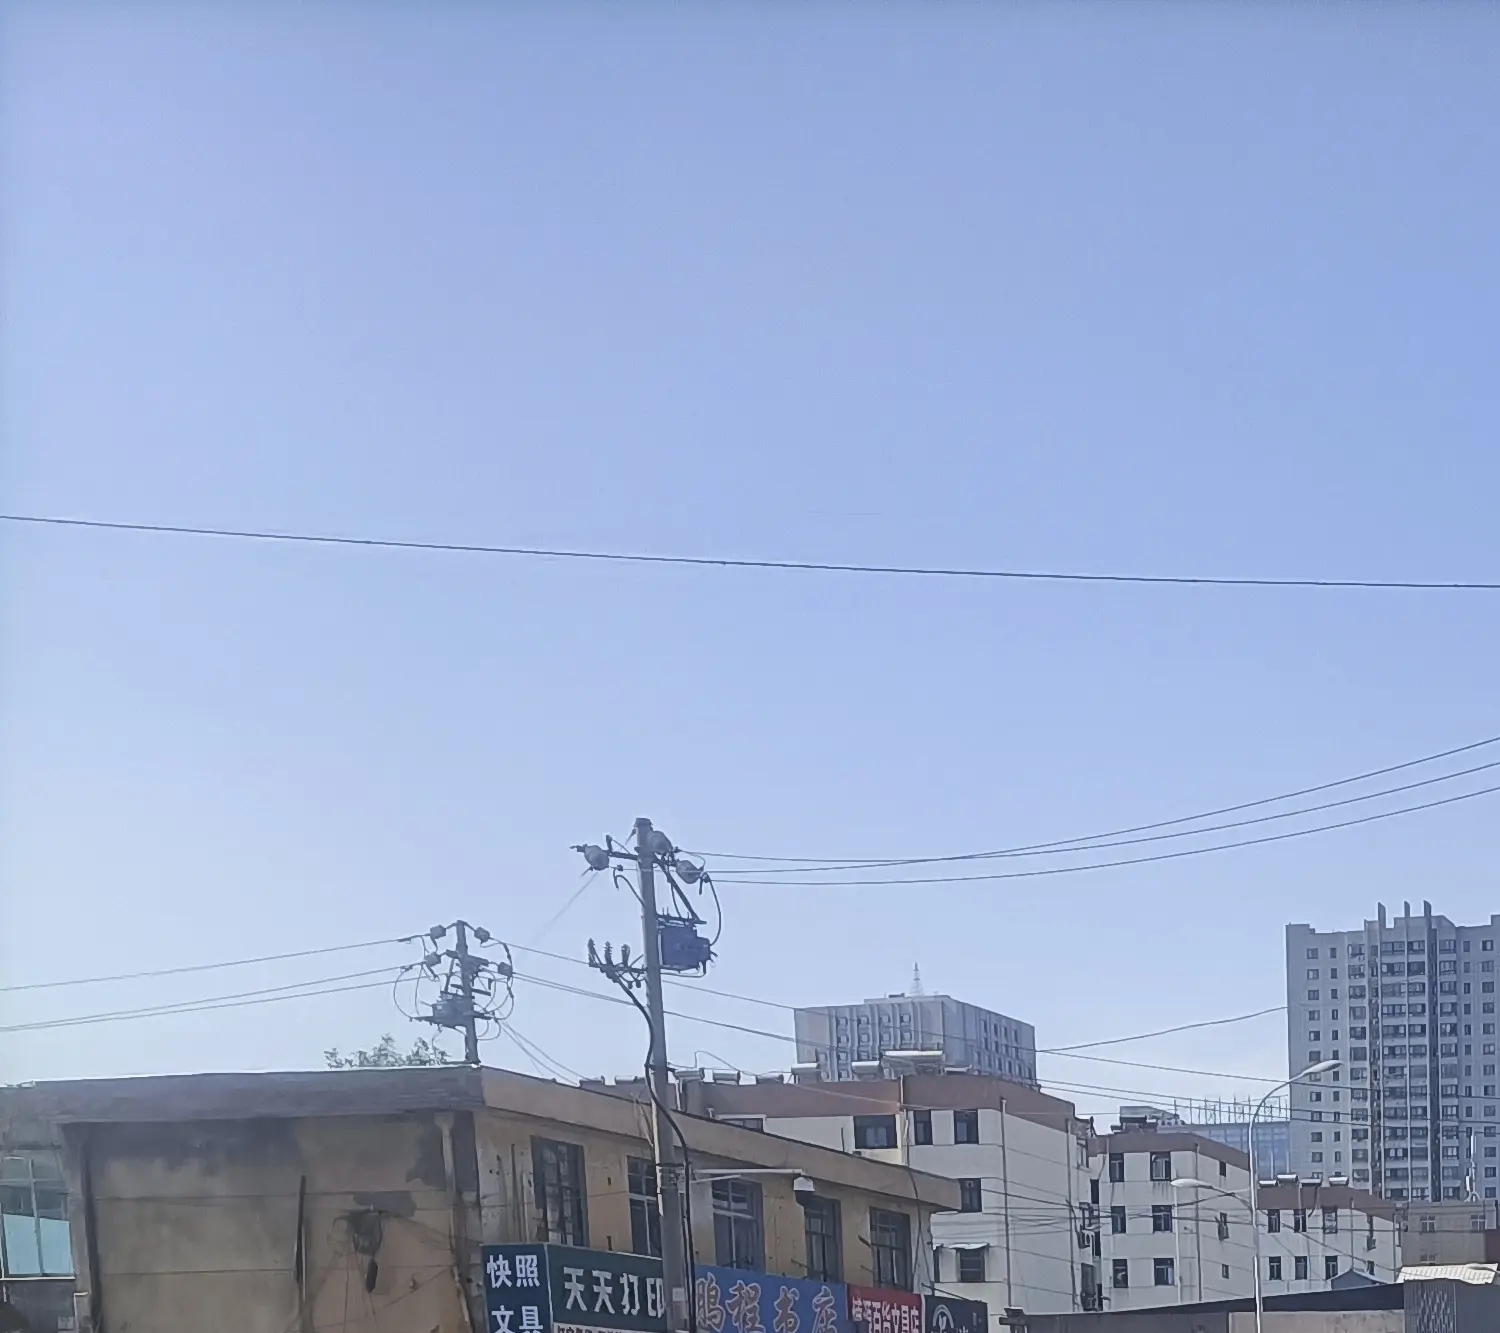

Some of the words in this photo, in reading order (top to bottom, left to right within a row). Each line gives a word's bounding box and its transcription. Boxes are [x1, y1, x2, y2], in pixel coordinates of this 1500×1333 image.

[486, 1254, 541, 1288] 快照
[563, 1266, 666, 1319] 天天打印
